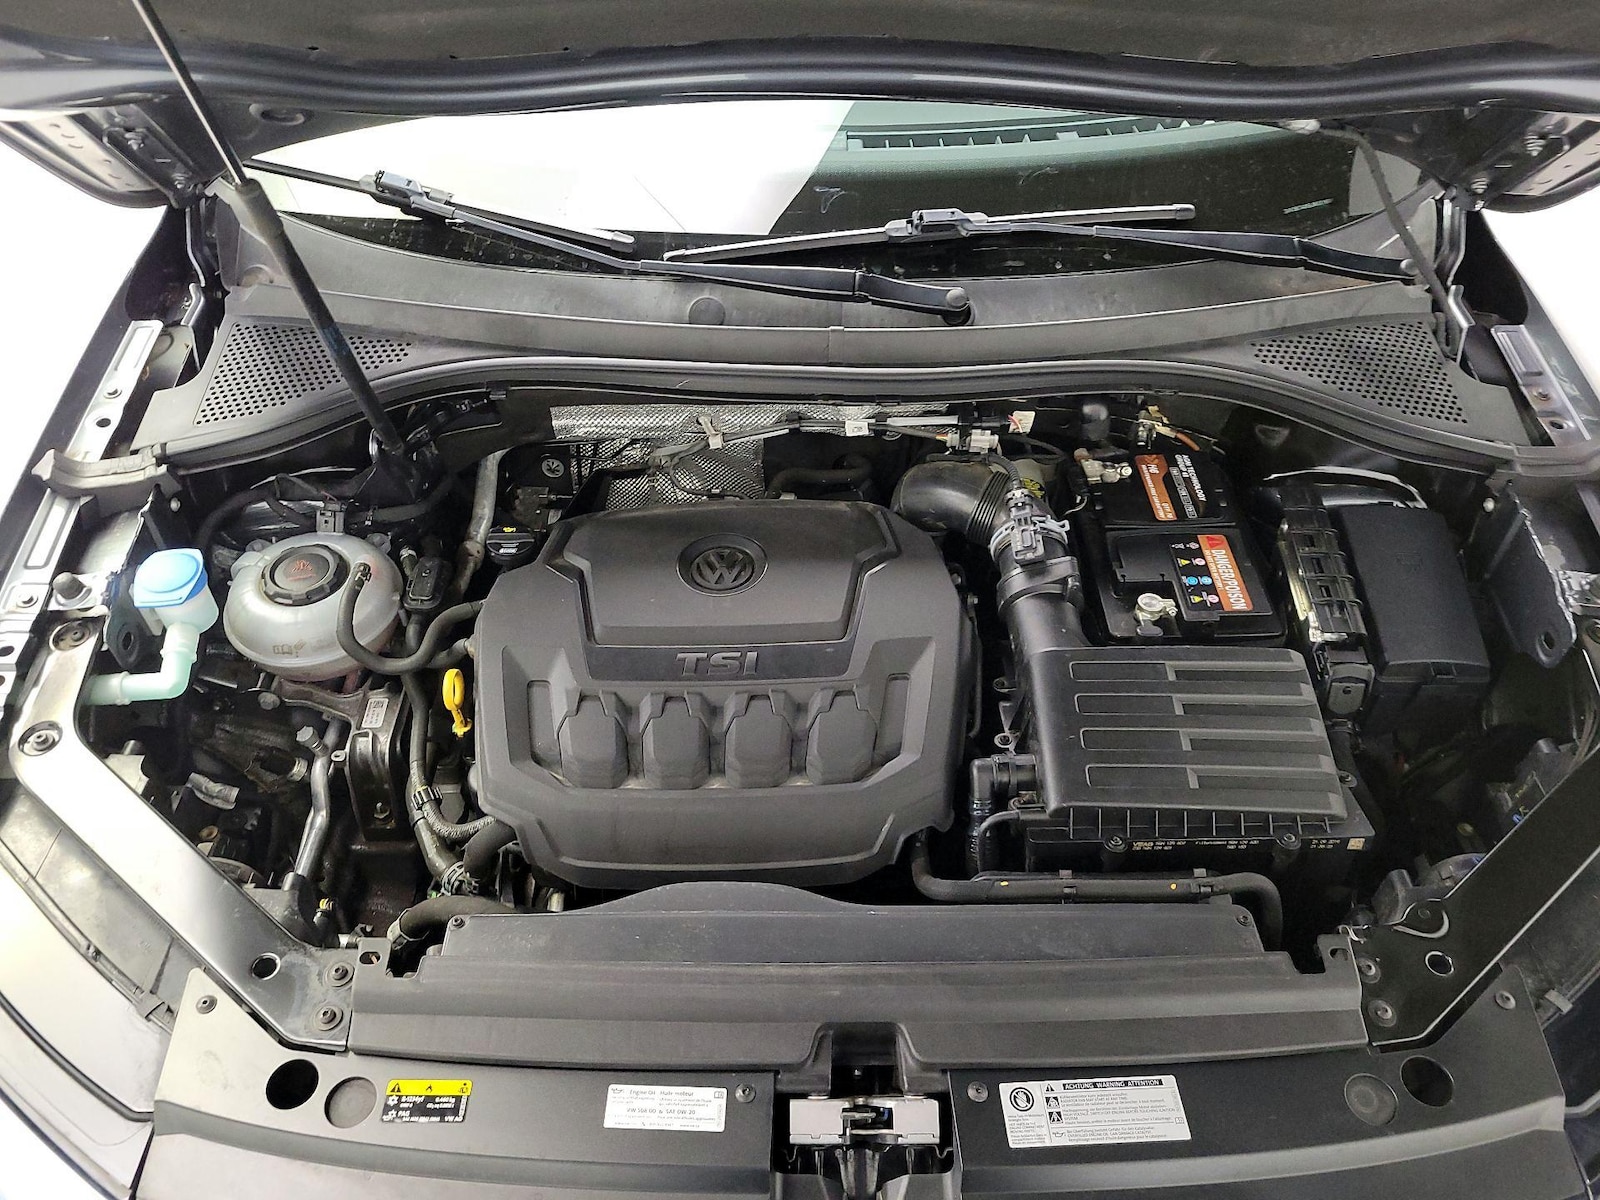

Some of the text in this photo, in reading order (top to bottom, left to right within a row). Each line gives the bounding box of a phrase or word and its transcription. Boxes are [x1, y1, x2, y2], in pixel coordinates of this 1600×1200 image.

[1187, 467, 1207, 501] TECHNOLOGY
[1211, 550, 1248, 610] DANGER/POISON
[676, 652, 758, 676] TSI
